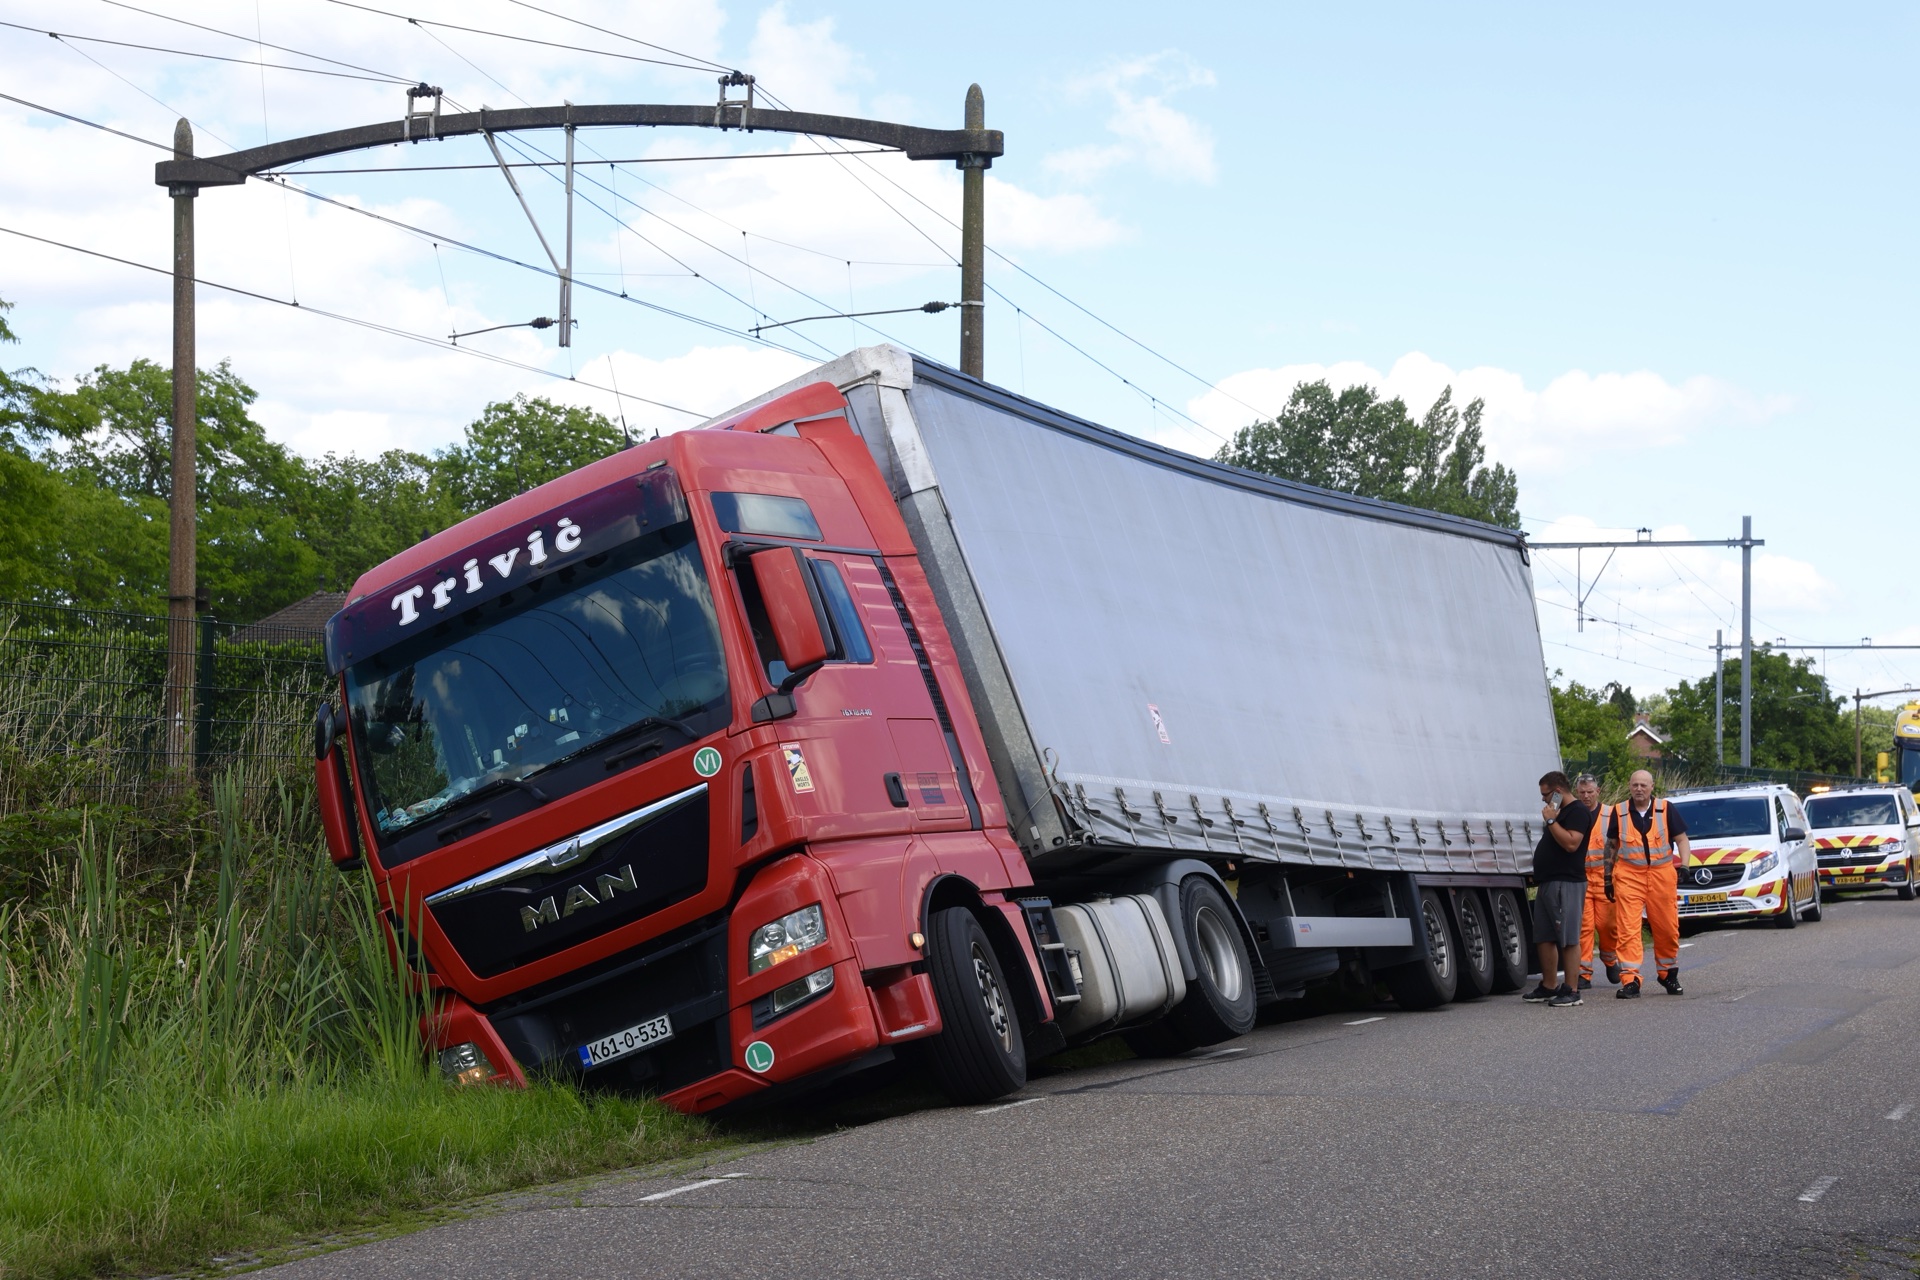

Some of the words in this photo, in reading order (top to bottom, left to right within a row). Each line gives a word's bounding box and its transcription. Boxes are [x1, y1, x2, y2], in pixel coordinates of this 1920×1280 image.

[697, 752, 717, 772] VI
[519, 864, 638, 933] MAN
[1690, 894, 1724, 903] VJR-04-L
[752, 1049, 769, 1068] L
